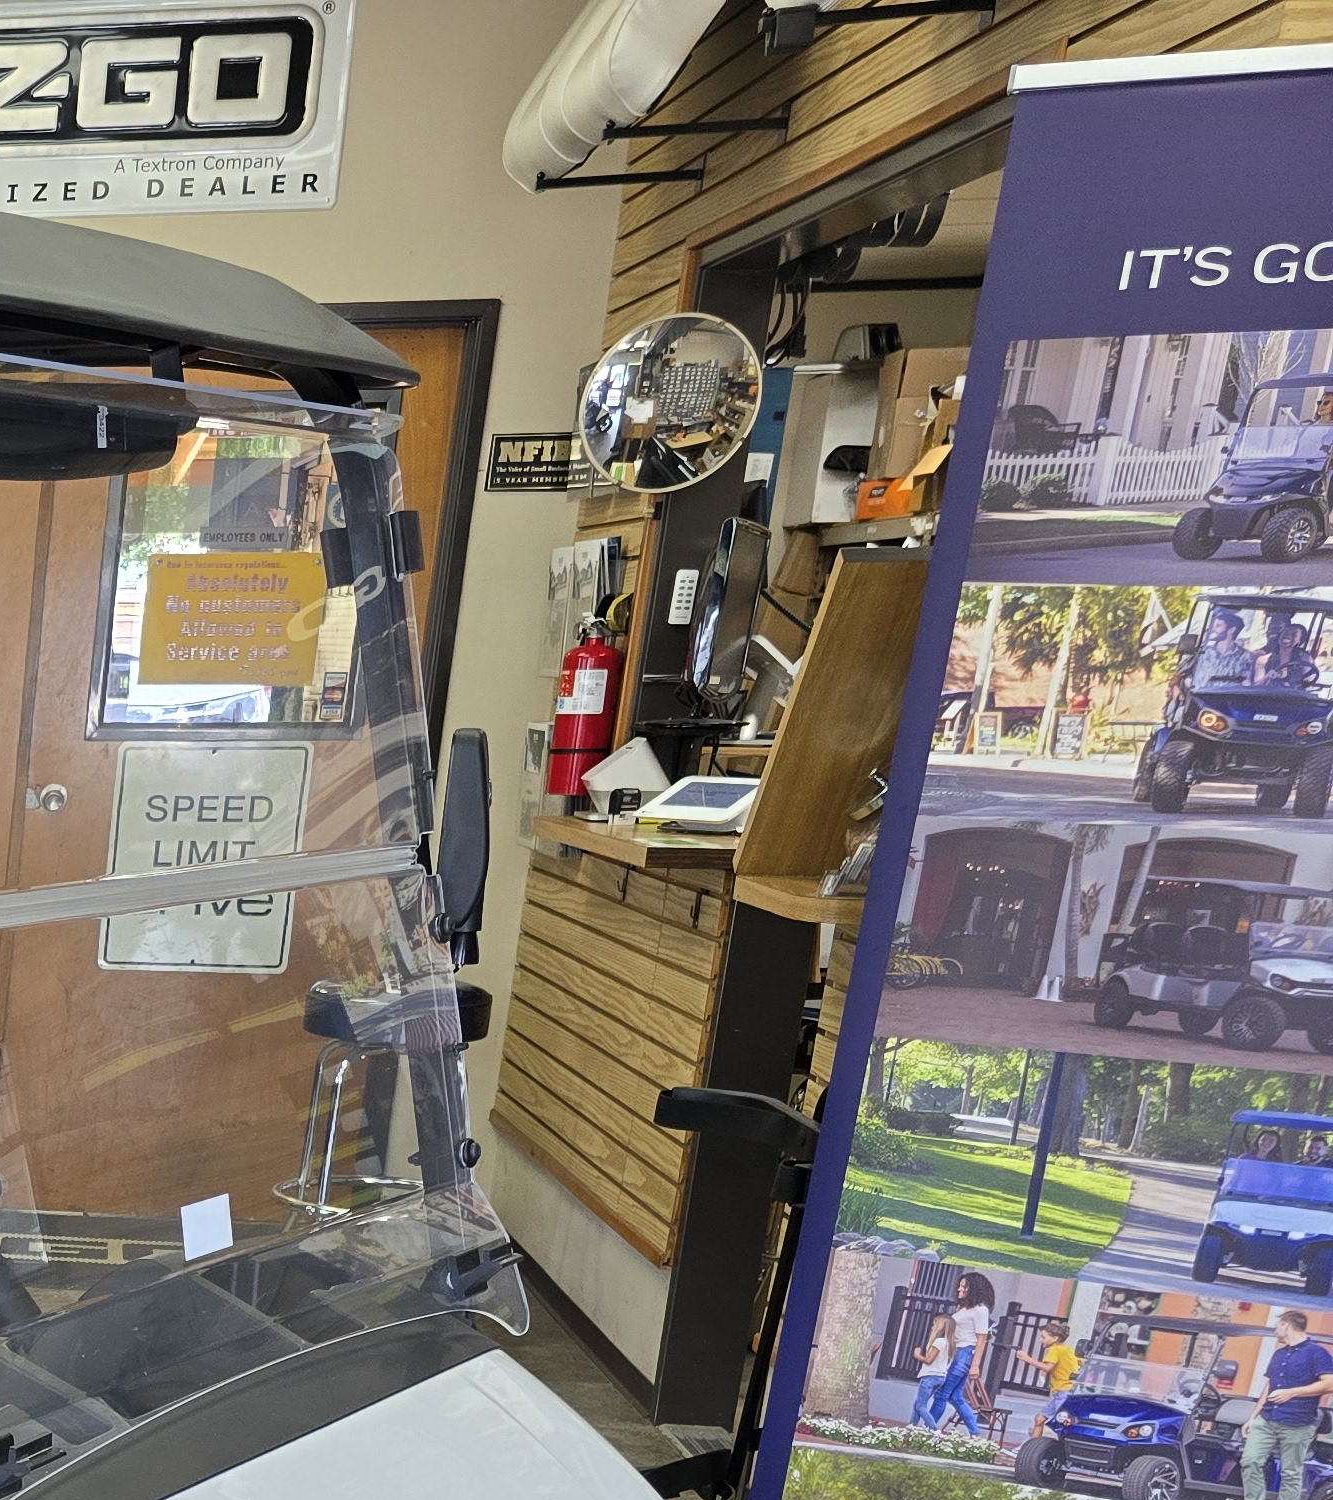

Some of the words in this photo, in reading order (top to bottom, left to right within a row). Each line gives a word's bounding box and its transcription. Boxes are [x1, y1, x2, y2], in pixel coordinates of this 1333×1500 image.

[114, 159, 125, 173] A
[133, 158, 196, 173] Textron
[203, 156, 285, 172] Company
[146, 173, 318, 199] DEALER
[1118, 246, 1232, 291] IT'S
[203, 532, 256, 543] EMPLOYEES
[259, 532, 285, 543] ONLY
[185, 574, 288, 594] Absolutely
[180, 619, 257, 637] Allowed
[265, 620, 283, 636] in
[166, 642, 239, 660] Service
[247, 644, 290, 660] area
[145, 795, 273, 822] SPEED
[153, 840, 255, 867] LIMIT
